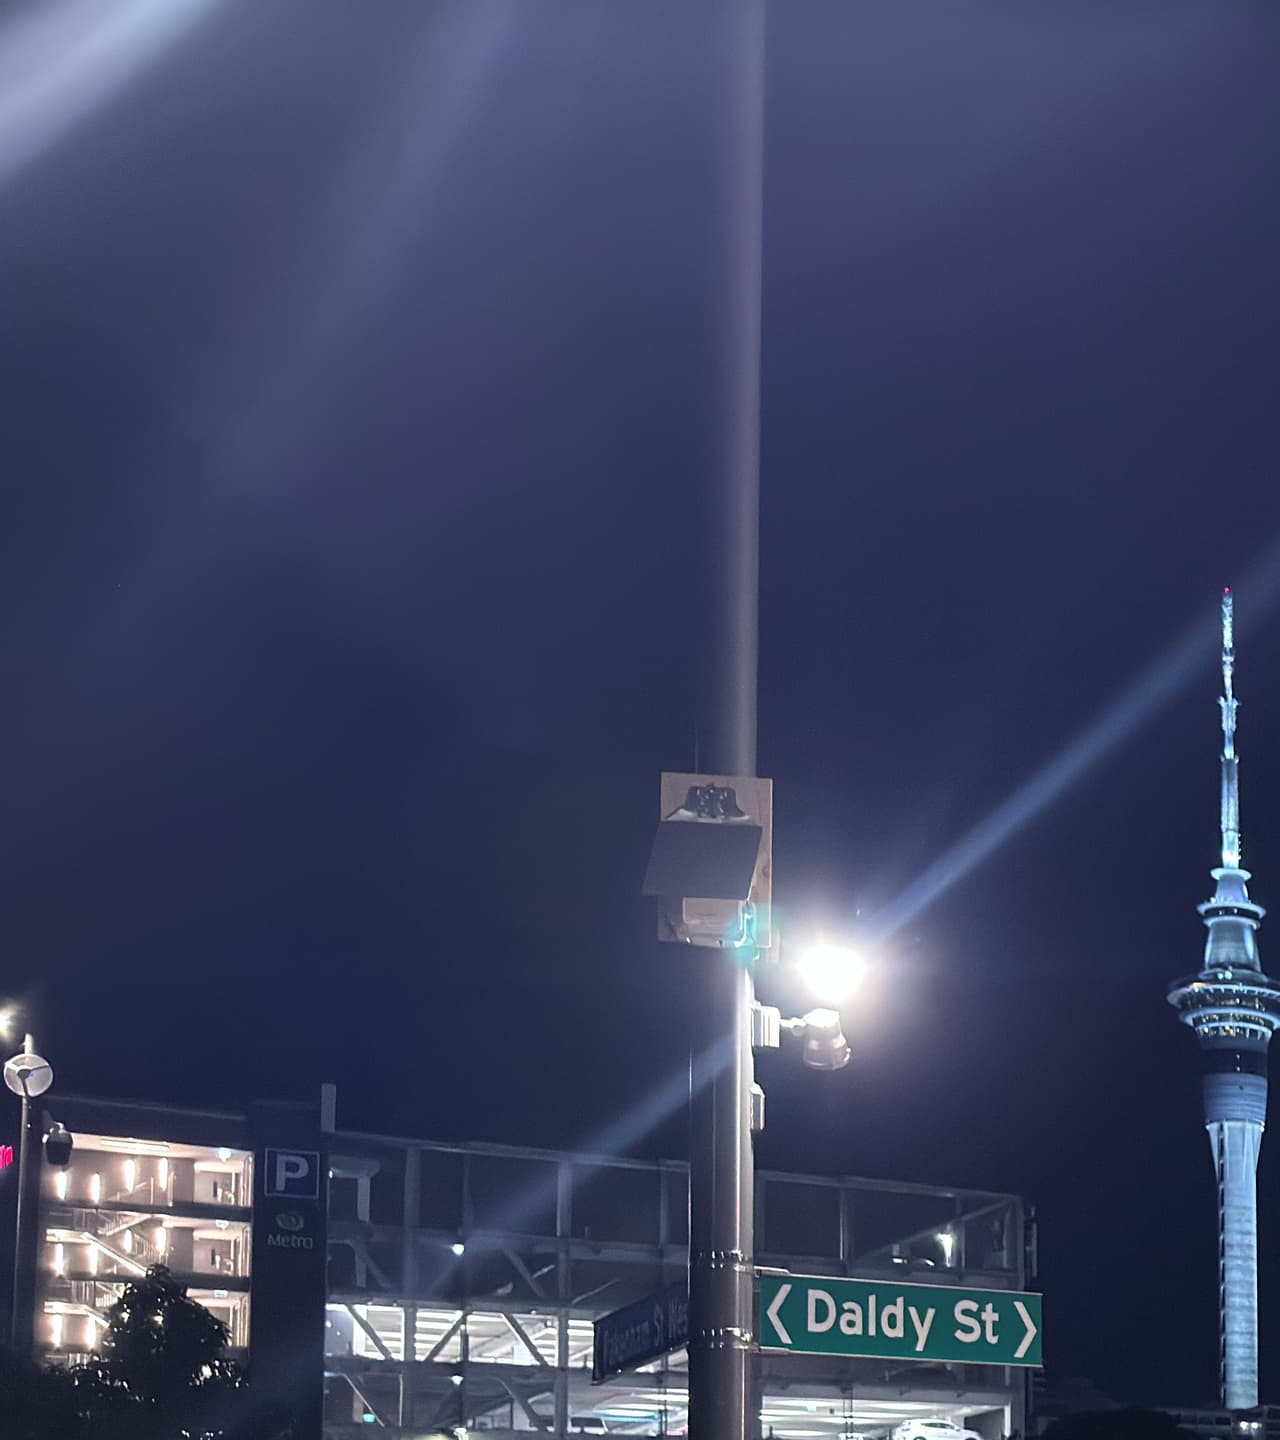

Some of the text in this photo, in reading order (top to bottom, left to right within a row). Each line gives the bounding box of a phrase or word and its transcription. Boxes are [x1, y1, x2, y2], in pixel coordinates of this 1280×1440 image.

[275, 1153, 309, 1191] P
[807, 1289, 999, 1351] Daldy St
